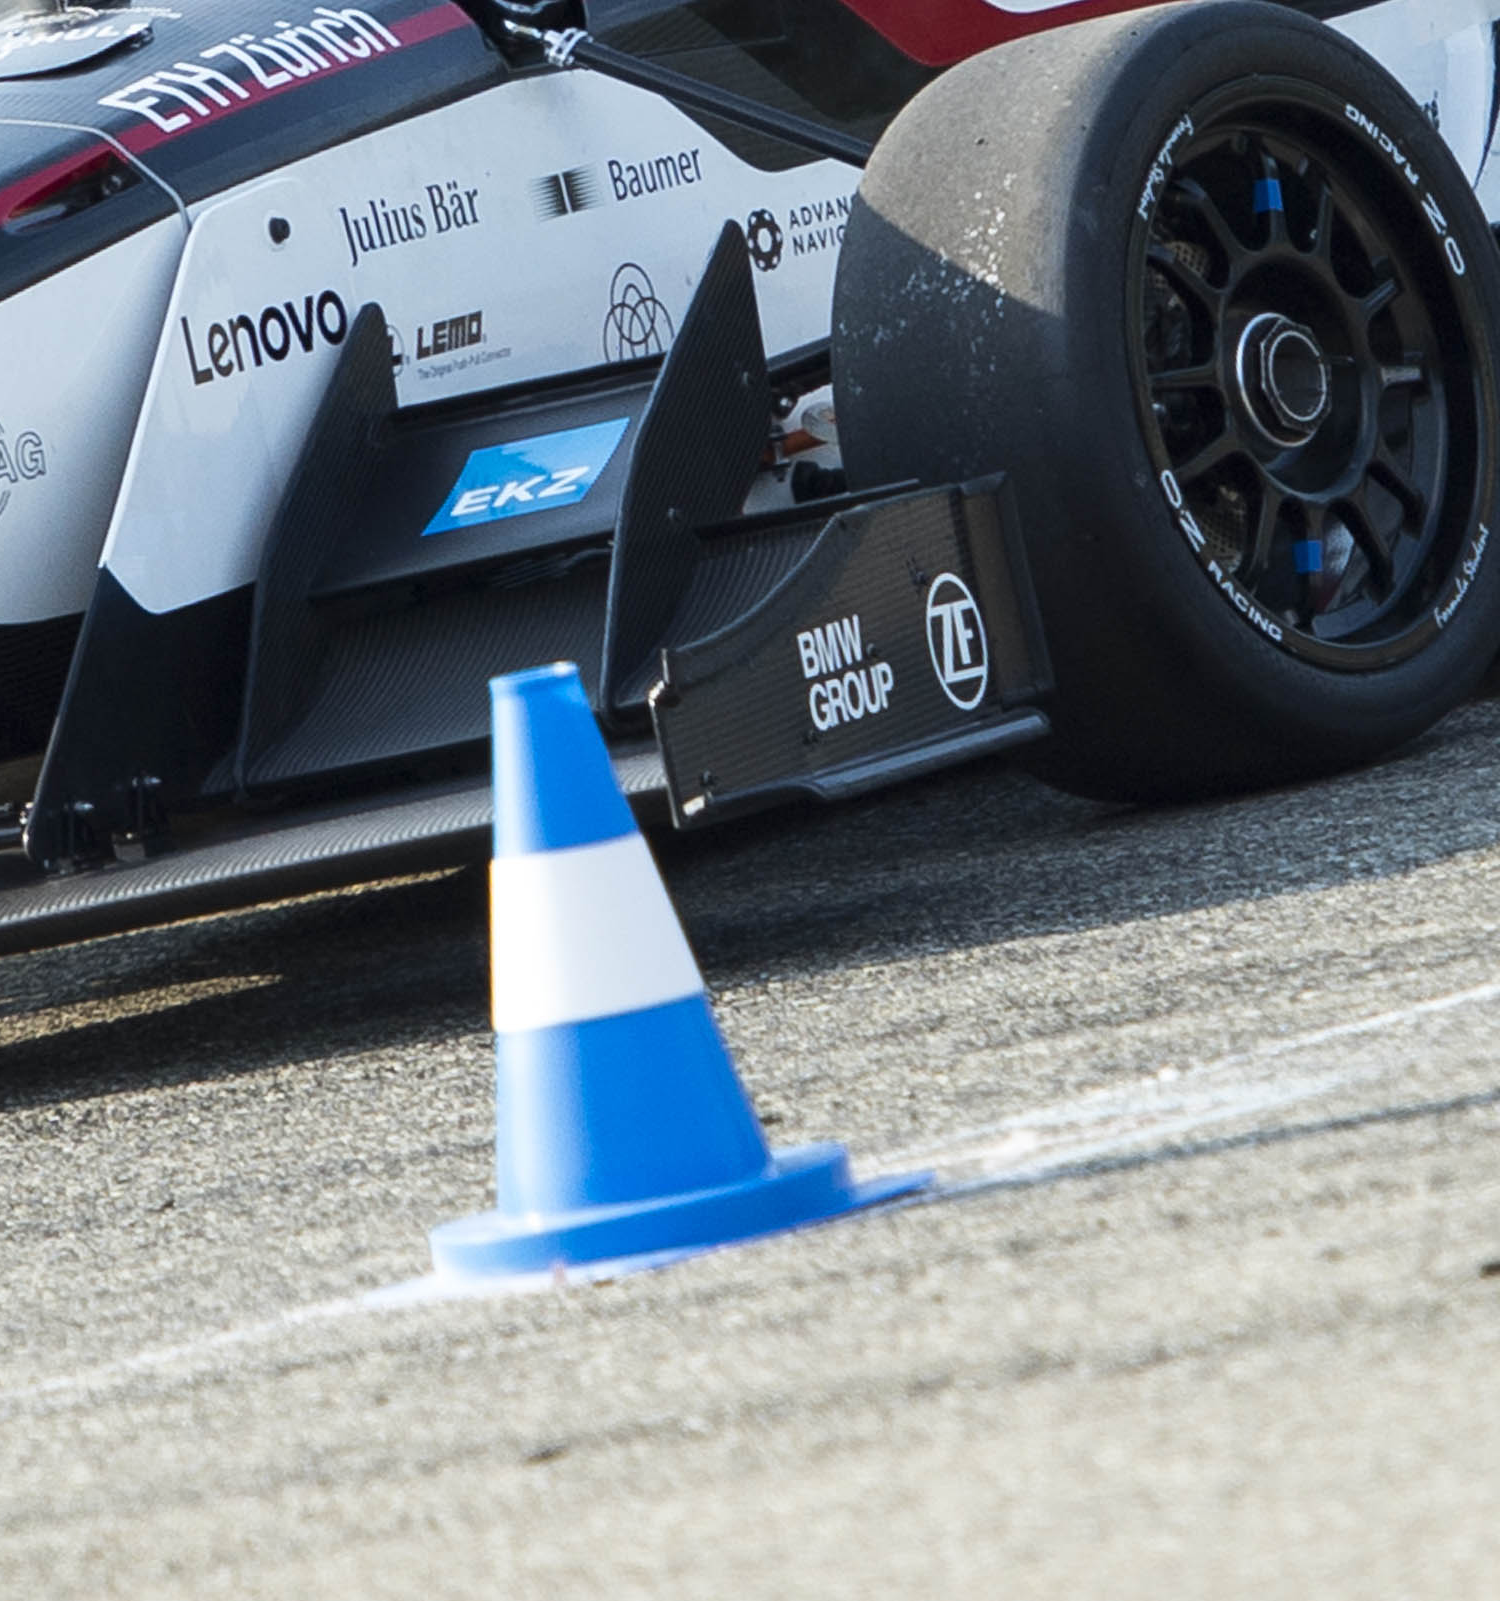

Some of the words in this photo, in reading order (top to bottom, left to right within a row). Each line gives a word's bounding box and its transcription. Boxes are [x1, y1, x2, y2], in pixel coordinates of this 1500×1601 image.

[99, 62, 250, 133] ETH
[199, 6, 402, 90] Zürich
[607, 148, 702, 201] Baumer
[1343, 103, 1420, 185] RACING
[338, 198, 427, 267] Julius
[425, 179, 480, 235] Bär
[789, 195, 851, 230] ADVAN
[180, 289, 348, 385] Lenovo
[450, 463, 590, 519] EKZ
[930, 599, 987, 684] ZF
[1208, 559, 1283, 642] RACING
[796, 613, 863, 680] BMW
[809, 661, 895, 732] GROUP
